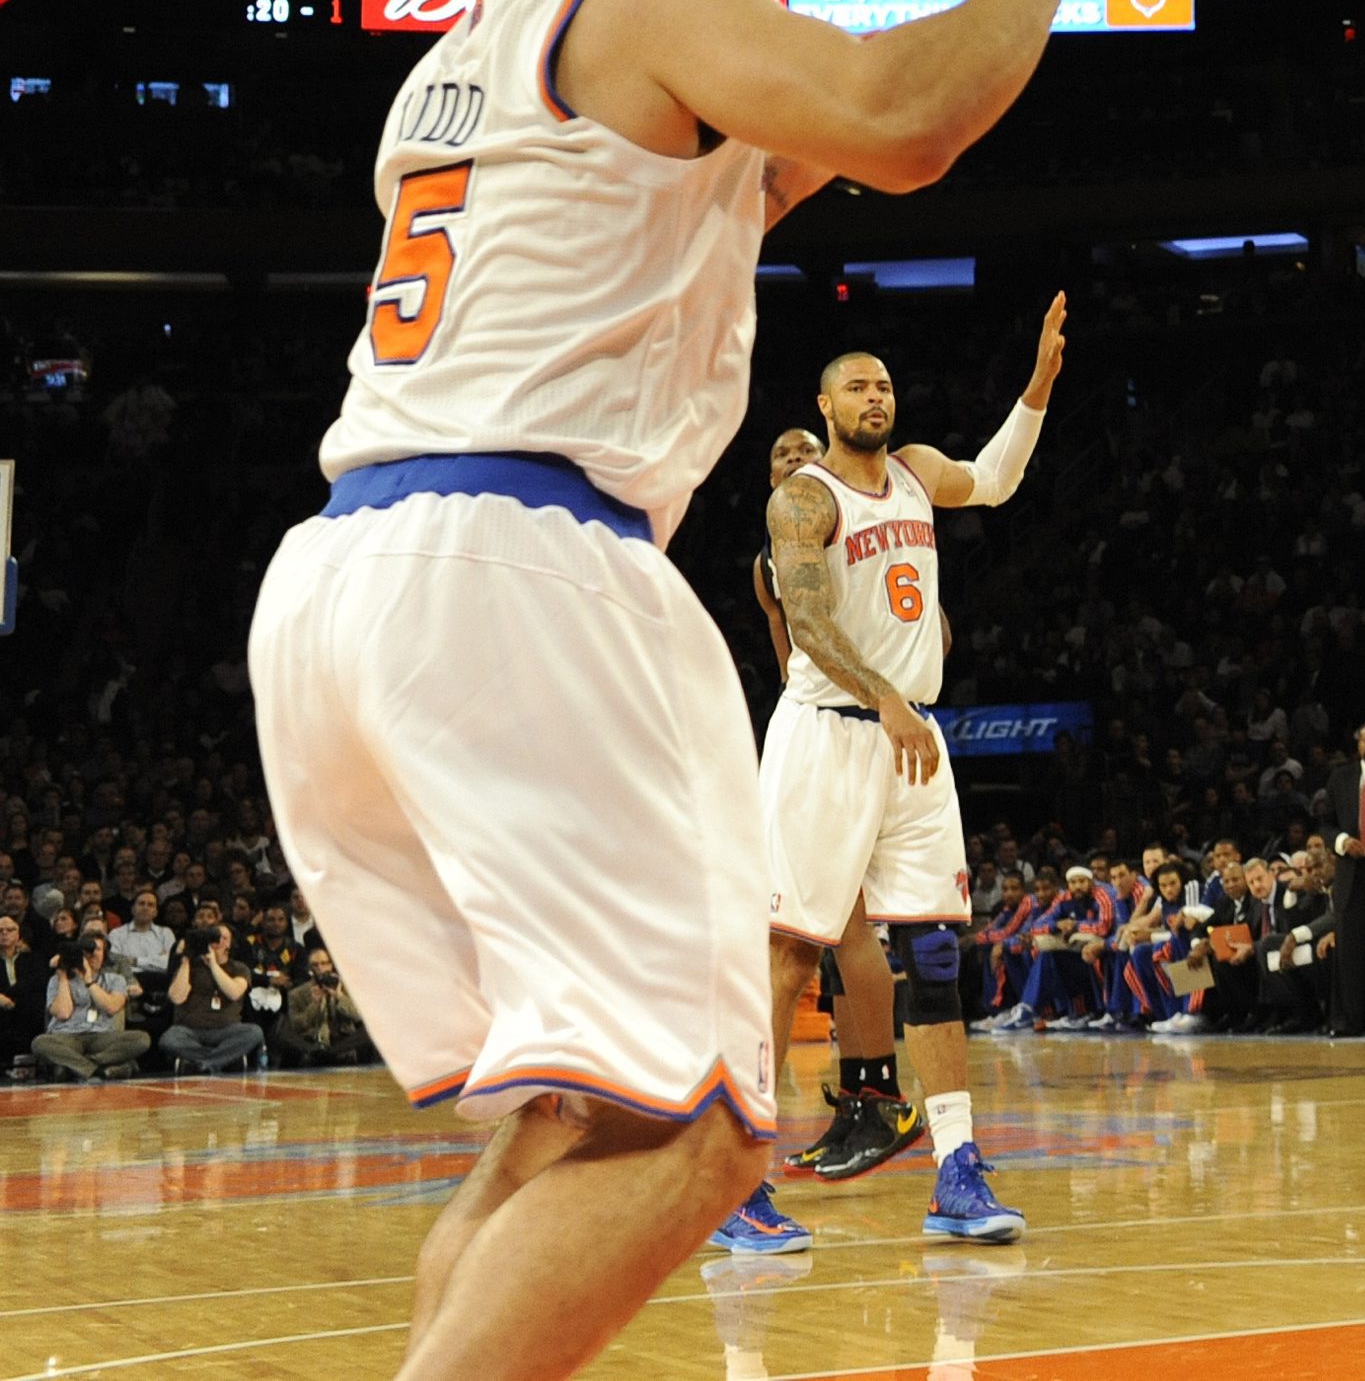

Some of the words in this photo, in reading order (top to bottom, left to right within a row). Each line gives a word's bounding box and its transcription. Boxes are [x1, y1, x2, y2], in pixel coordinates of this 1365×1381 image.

[330, 0, 343, 23] 1
[398, 82, 484, 146] IDD
[369, 158, 475, 366] 5
[845, 521, 889, 566] NEW
[885, 519, 935, 549] YORK
[885, 562, 923, 623] 6
[956, 717, 1058, 740] LIGHT
